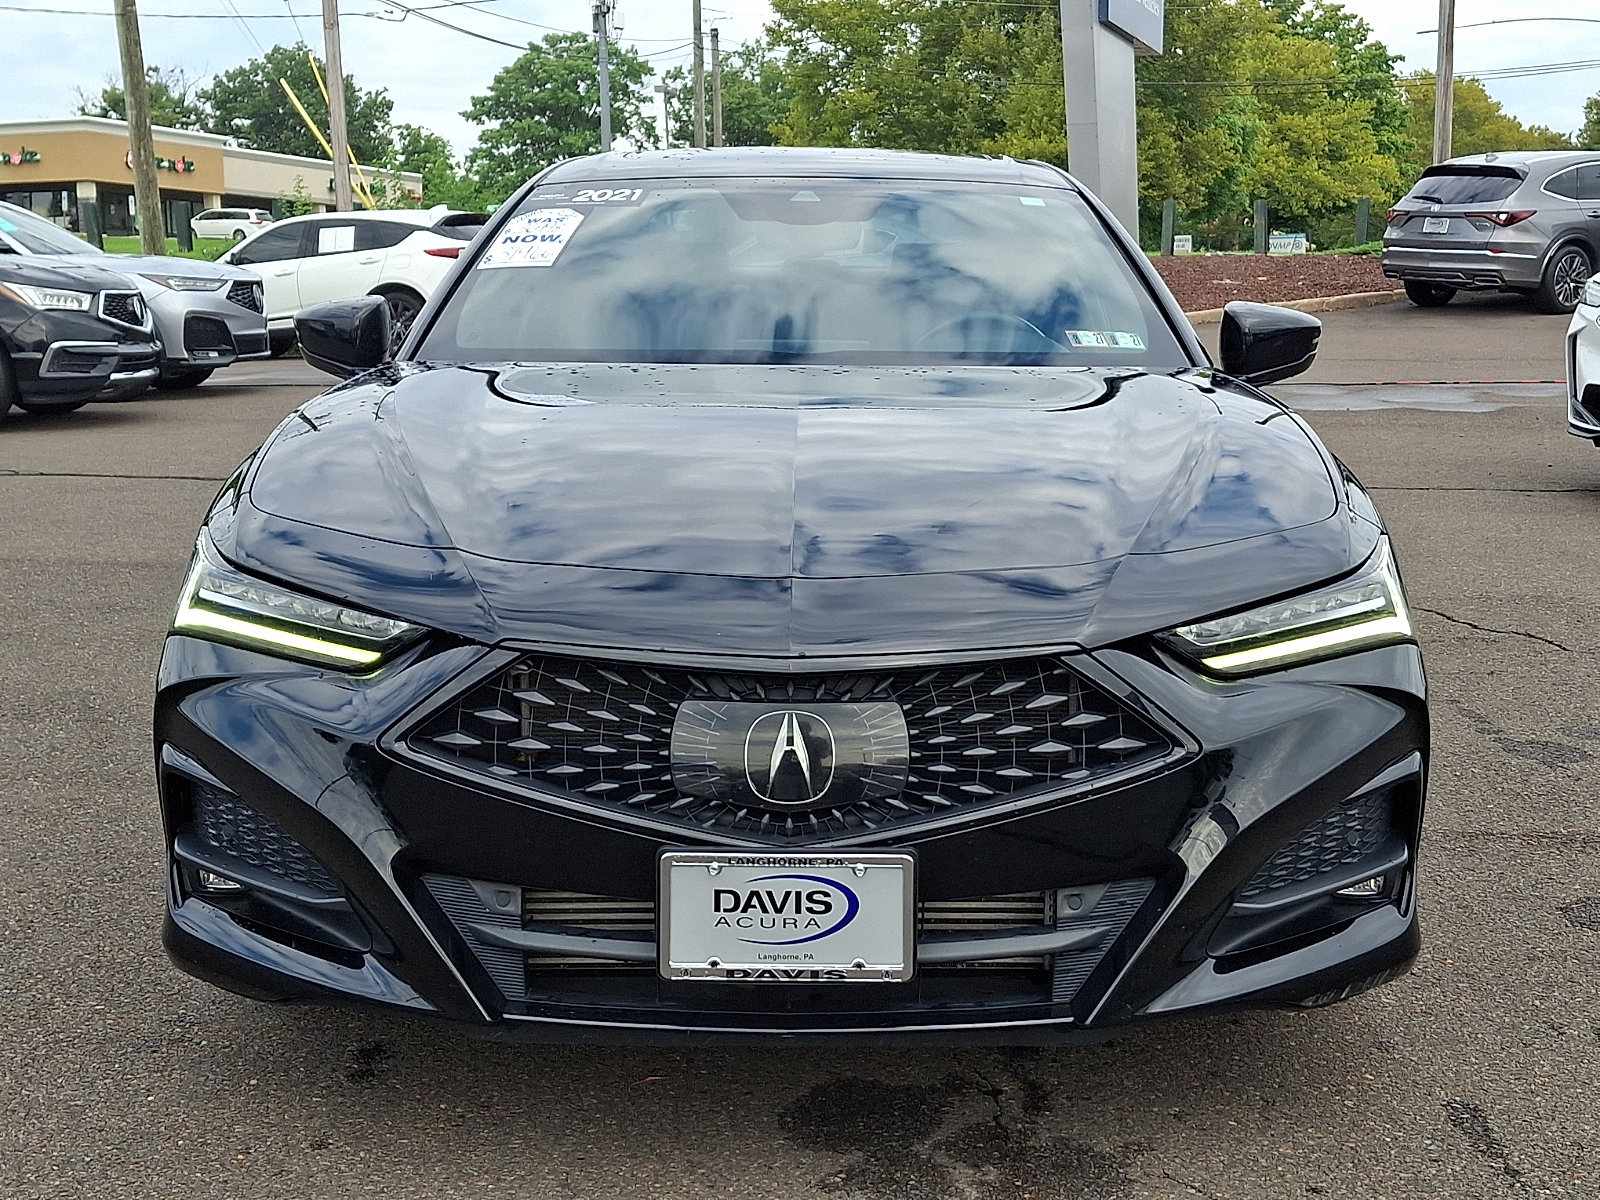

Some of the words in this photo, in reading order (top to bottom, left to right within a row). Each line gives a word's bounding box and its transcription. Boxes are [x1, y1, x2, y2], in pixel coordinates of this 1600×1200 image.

[571, 188, 643, 202] 2021
[712, 889, 834, 915] DAVIS
[713, 916, 822, 929] ACURA
[757, 952, 802, 962] Langhorne,
[803, 953, 815, 961] PA
[725, 968, 849, 980] DAVIS
